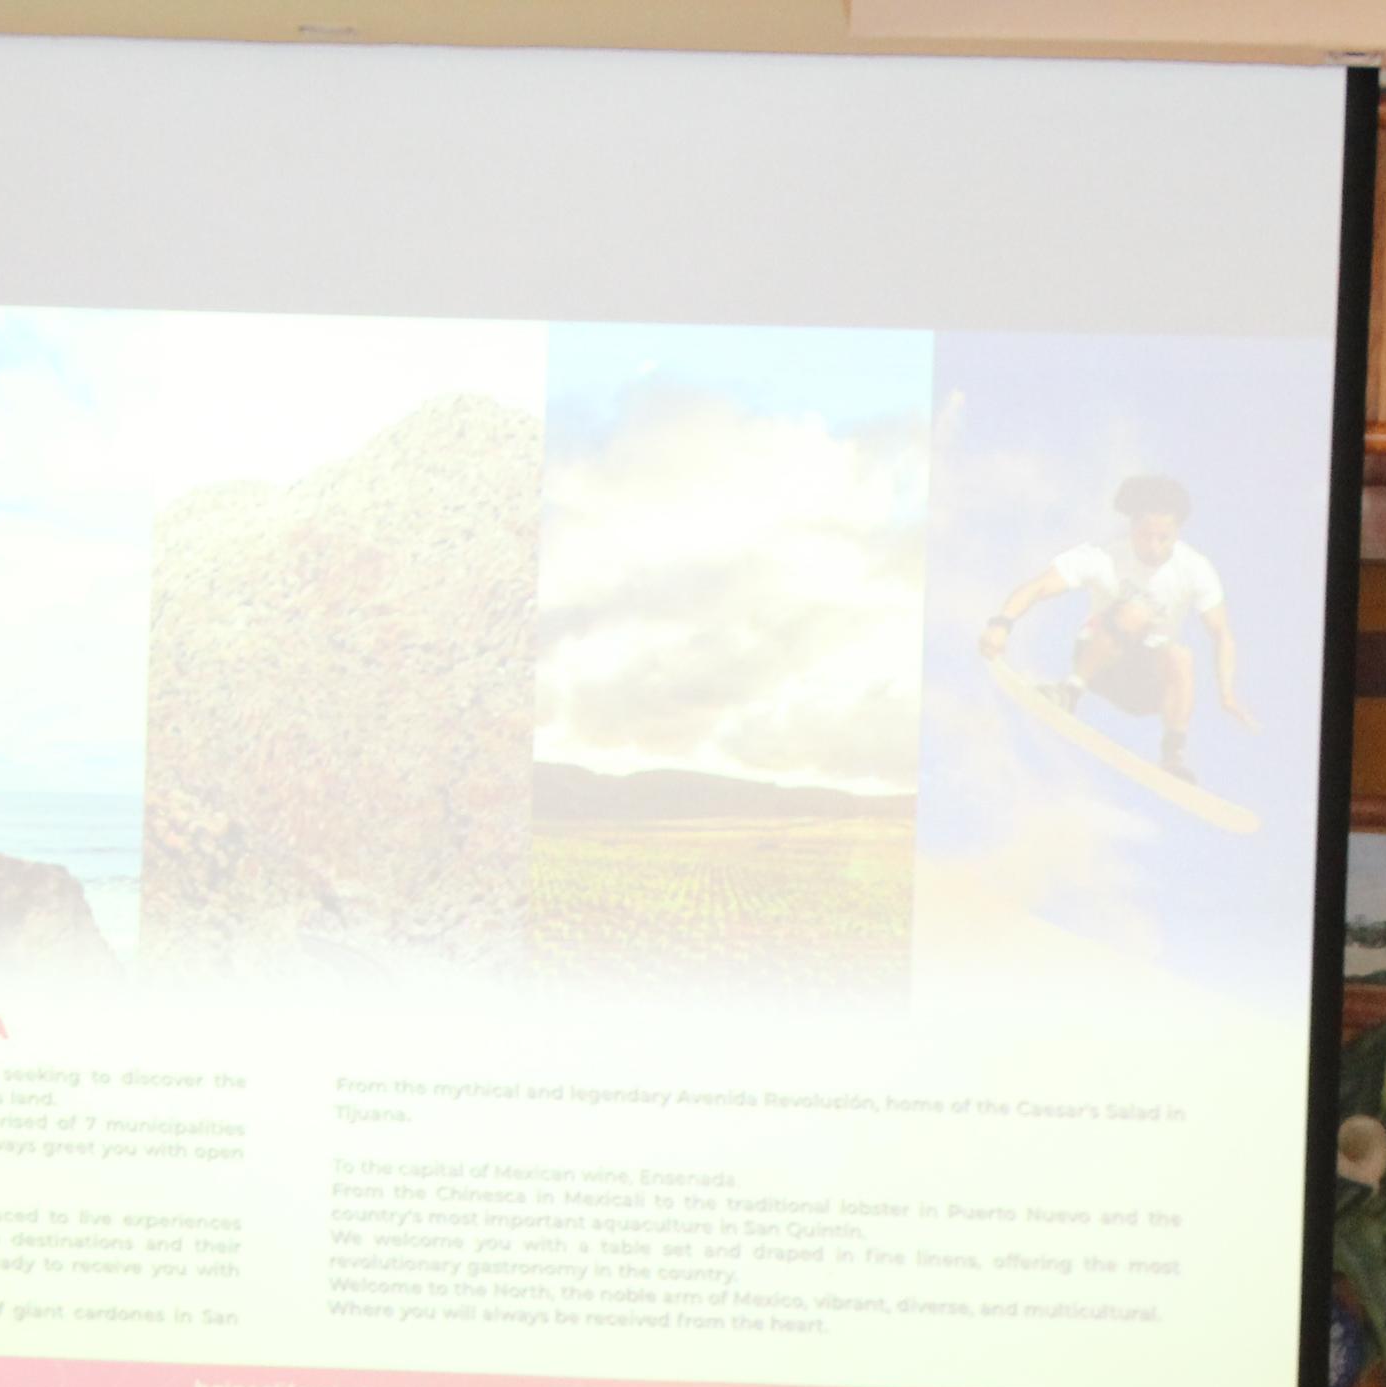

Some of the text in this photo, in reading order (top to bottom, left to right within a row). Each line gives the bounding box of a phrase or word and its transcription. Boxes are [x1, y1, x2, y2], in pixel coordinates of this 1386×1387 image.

[2, 1064, 83, 1088] seeking
[118, 1067, 206, 1087] discover
[212, 1070, 249, 1088] the
[335, 1074, 387, 1094] From
[393, 1076, 427, 1095] the
[432, 1077, 520, 1103] mythical
[570, 1082, 672, 1108] legendary
[885, 1092, 944, 1112] home
[1105, 1100, 1161, 1120] Salad
[105, 1114, 247, 1140] municipalities
[41, 1136, 96, 1159] greet
[143, 1138, 188, 1156] with
[193, 1145, 245, 1163] open
[397, 1158, 465, 1183] capital
[493, 1161, 576, 1181] Mexican
[330, 1179, 1092, 1224] From the Chinesca Mexicali the traditional lobster Puerto Nuevo
[77, 1207, 114, 1226] live
[121, 1209, 244, 1235] experiences
[427, 1208, 479, 1225] most
[483, 1208, 586, 1234] important
[590, 1212, 713, 1238] aquaculture
[743, 1217, 781, 1235] San
[9, 1228, 135, 1250] destinations
[193, 1235, 244, 1253] their
[373, 1228, 465, 1249] welcome
[473, 1237, 512, 1255] you
[522, 1234, 568, 1252] with
[599, 1236, 652, 1255] table
[661, 1240, 693, 1256] set
[703, 1240, 743, 1258] and
[751, 1241, 825, 1266] draped
[863, 1245, 907, 1264] fine
[989, 1249, 1075, 1274] offering
[1123, 1256, 1185, 1273] most
[71, 1254, 143, 1274] receive
[151, 1262, 188, 1280] you
[196, 1258, 241, 1277] with
[326, 1251, 463, 1277] revolutionary
[466, 1257, 589, 1281] gastronomy
[328, 1273, 423, 1294] Welcome
[453, 1278, 488, 1296] the
[560, 1282, 595, 1300] the
[599, 1283, 657, 1302] noble
[662, 1291, 703, 1304] arm
[12, 1299, 63, 1323] giant
[202, 1306, 238, 1324] San
[327, 1298, 394, 1317] Where
[442, 1302, 476, 1320] will
[482, 1303, 550, 1328] always
[585, 1307, 670, 1327] received
[676, 1310, 725, 1329] from
[731, 1312, 764, 1331] the
